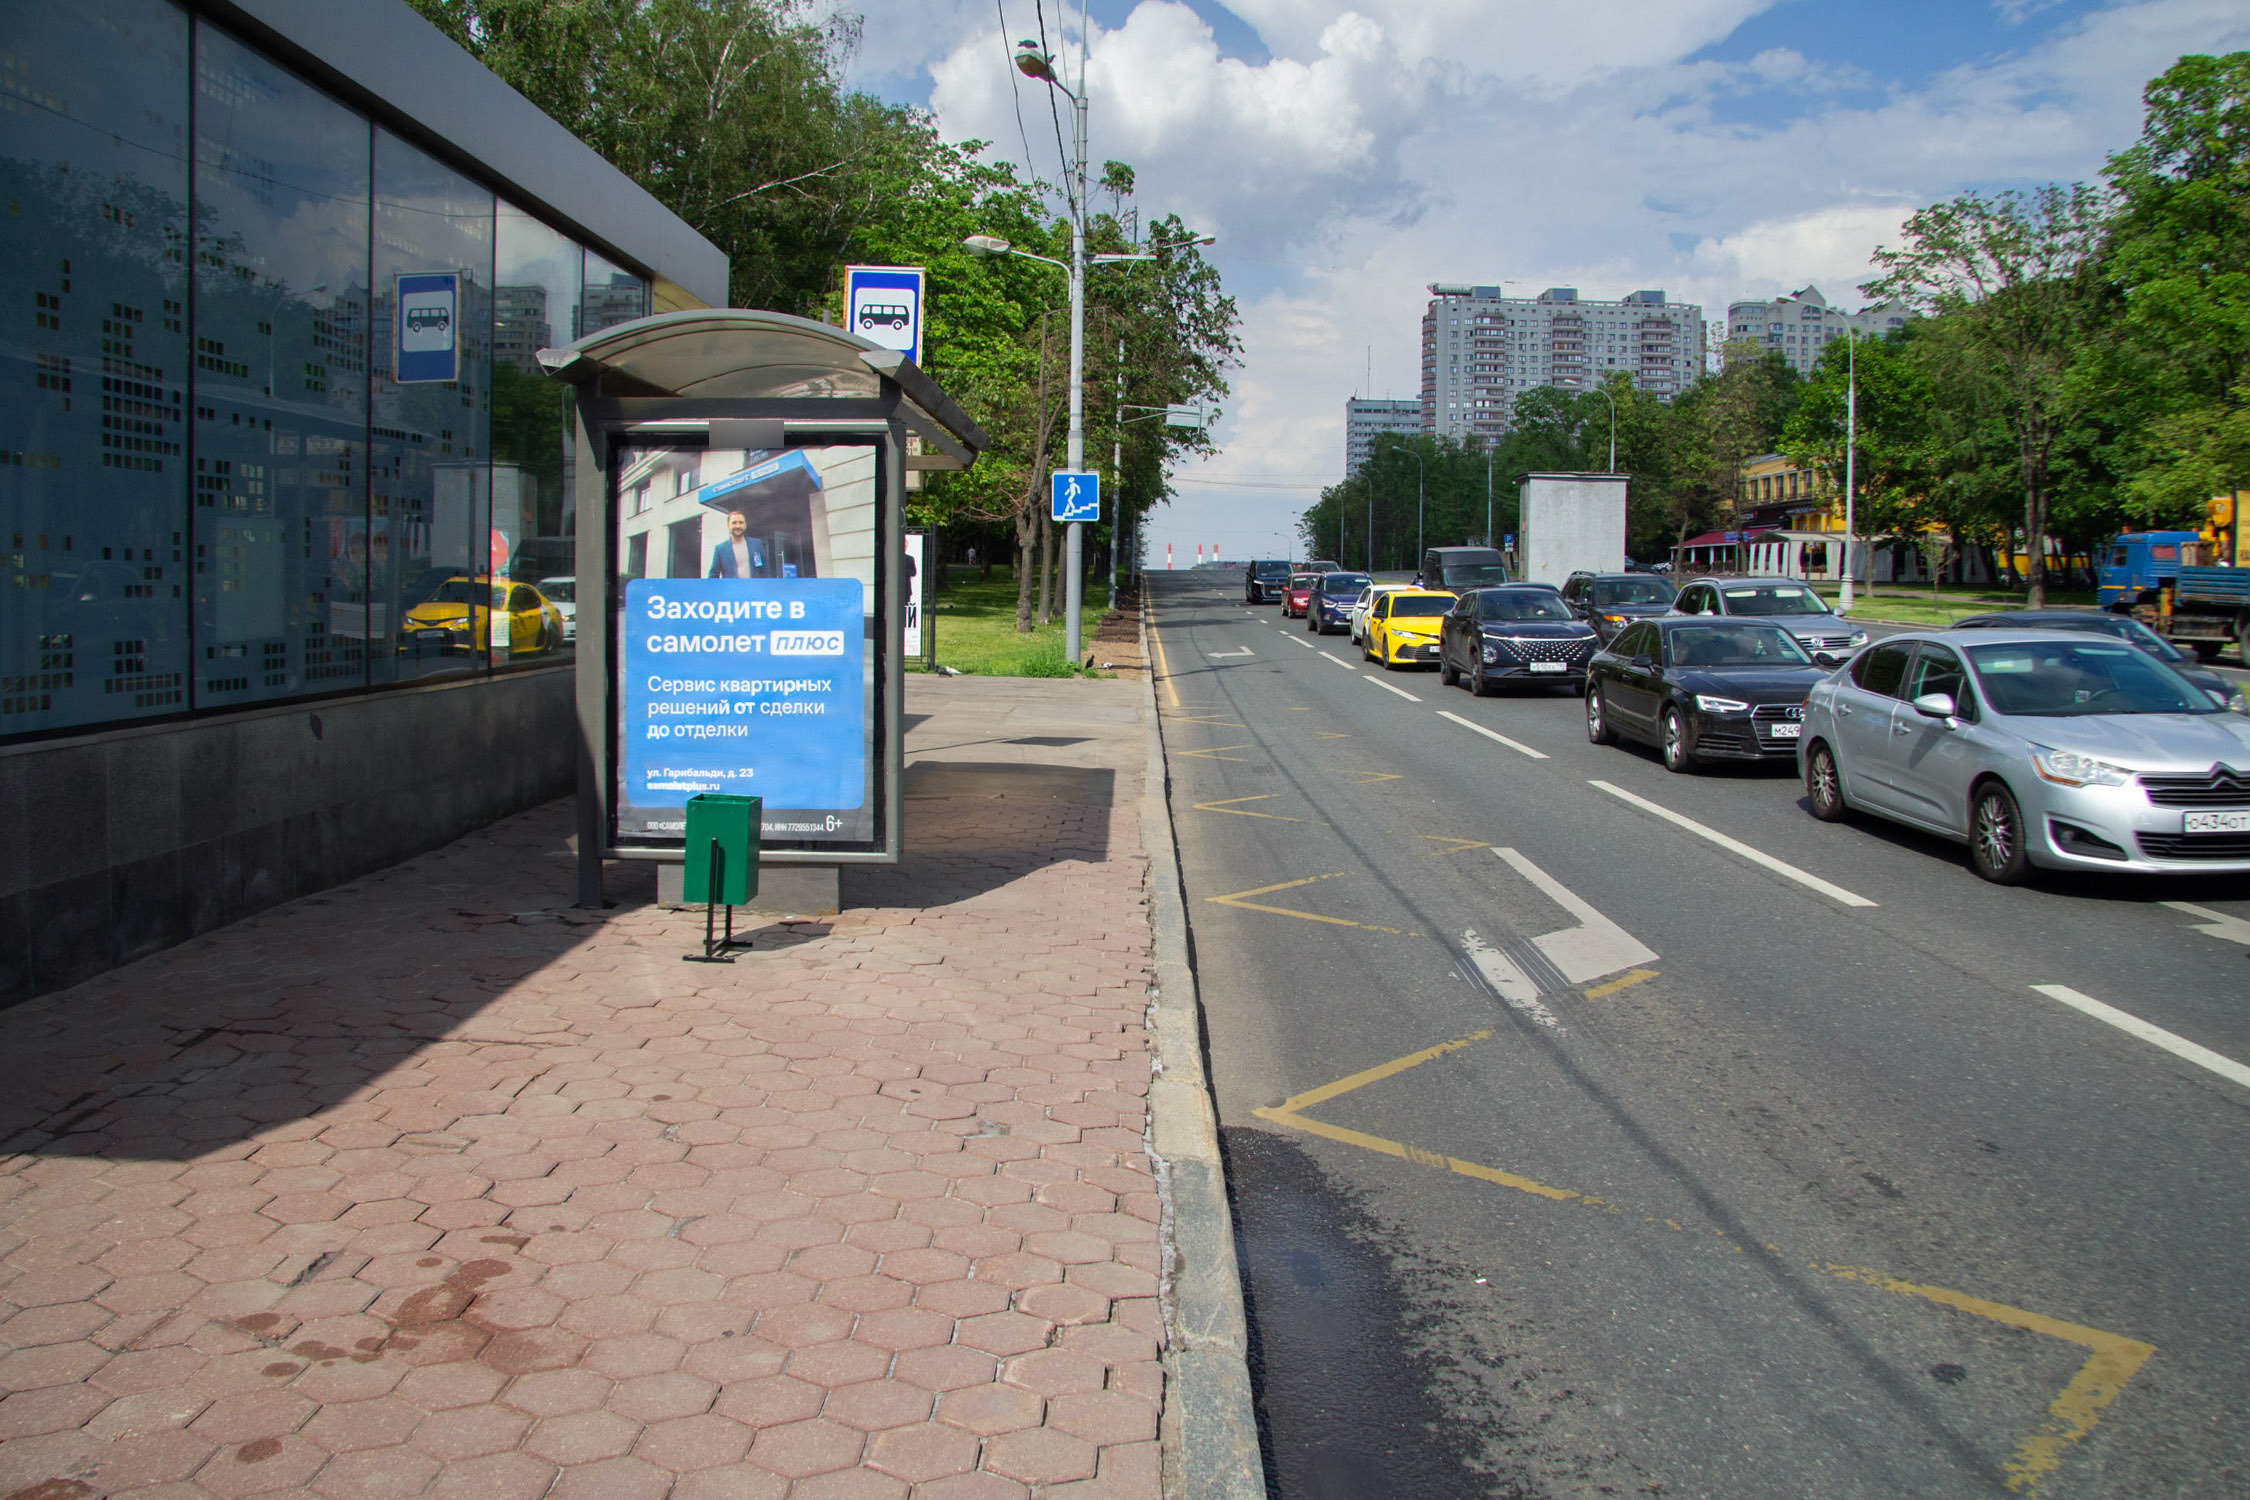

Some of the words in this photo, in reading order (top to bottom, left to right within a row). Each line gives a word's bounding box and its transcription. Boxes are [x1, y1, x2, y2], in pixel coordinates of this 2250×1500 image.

[647, 596, 782, 623] Заходите
[790, 601, 805, 619] в
[647, 634, 766, 653] самолет
[648, 676, 716, 695] Сервис
[720, 680, 832, 696] квартирных
[648, 700, 730, 718] решений
[734, 702, 755, 715] от
[760, 702, 825, 717] сделки
[647, 725, 670, 740] до
[674, 725, 748, 740] отделки
[647, 769, 661, 779] ул.
[664, 768, 726, 779] Гарибальди,
[727, 770, 737, 778] д.
[739, 768, 754, 778] 23
[826, 815, 843, 832] 6+
